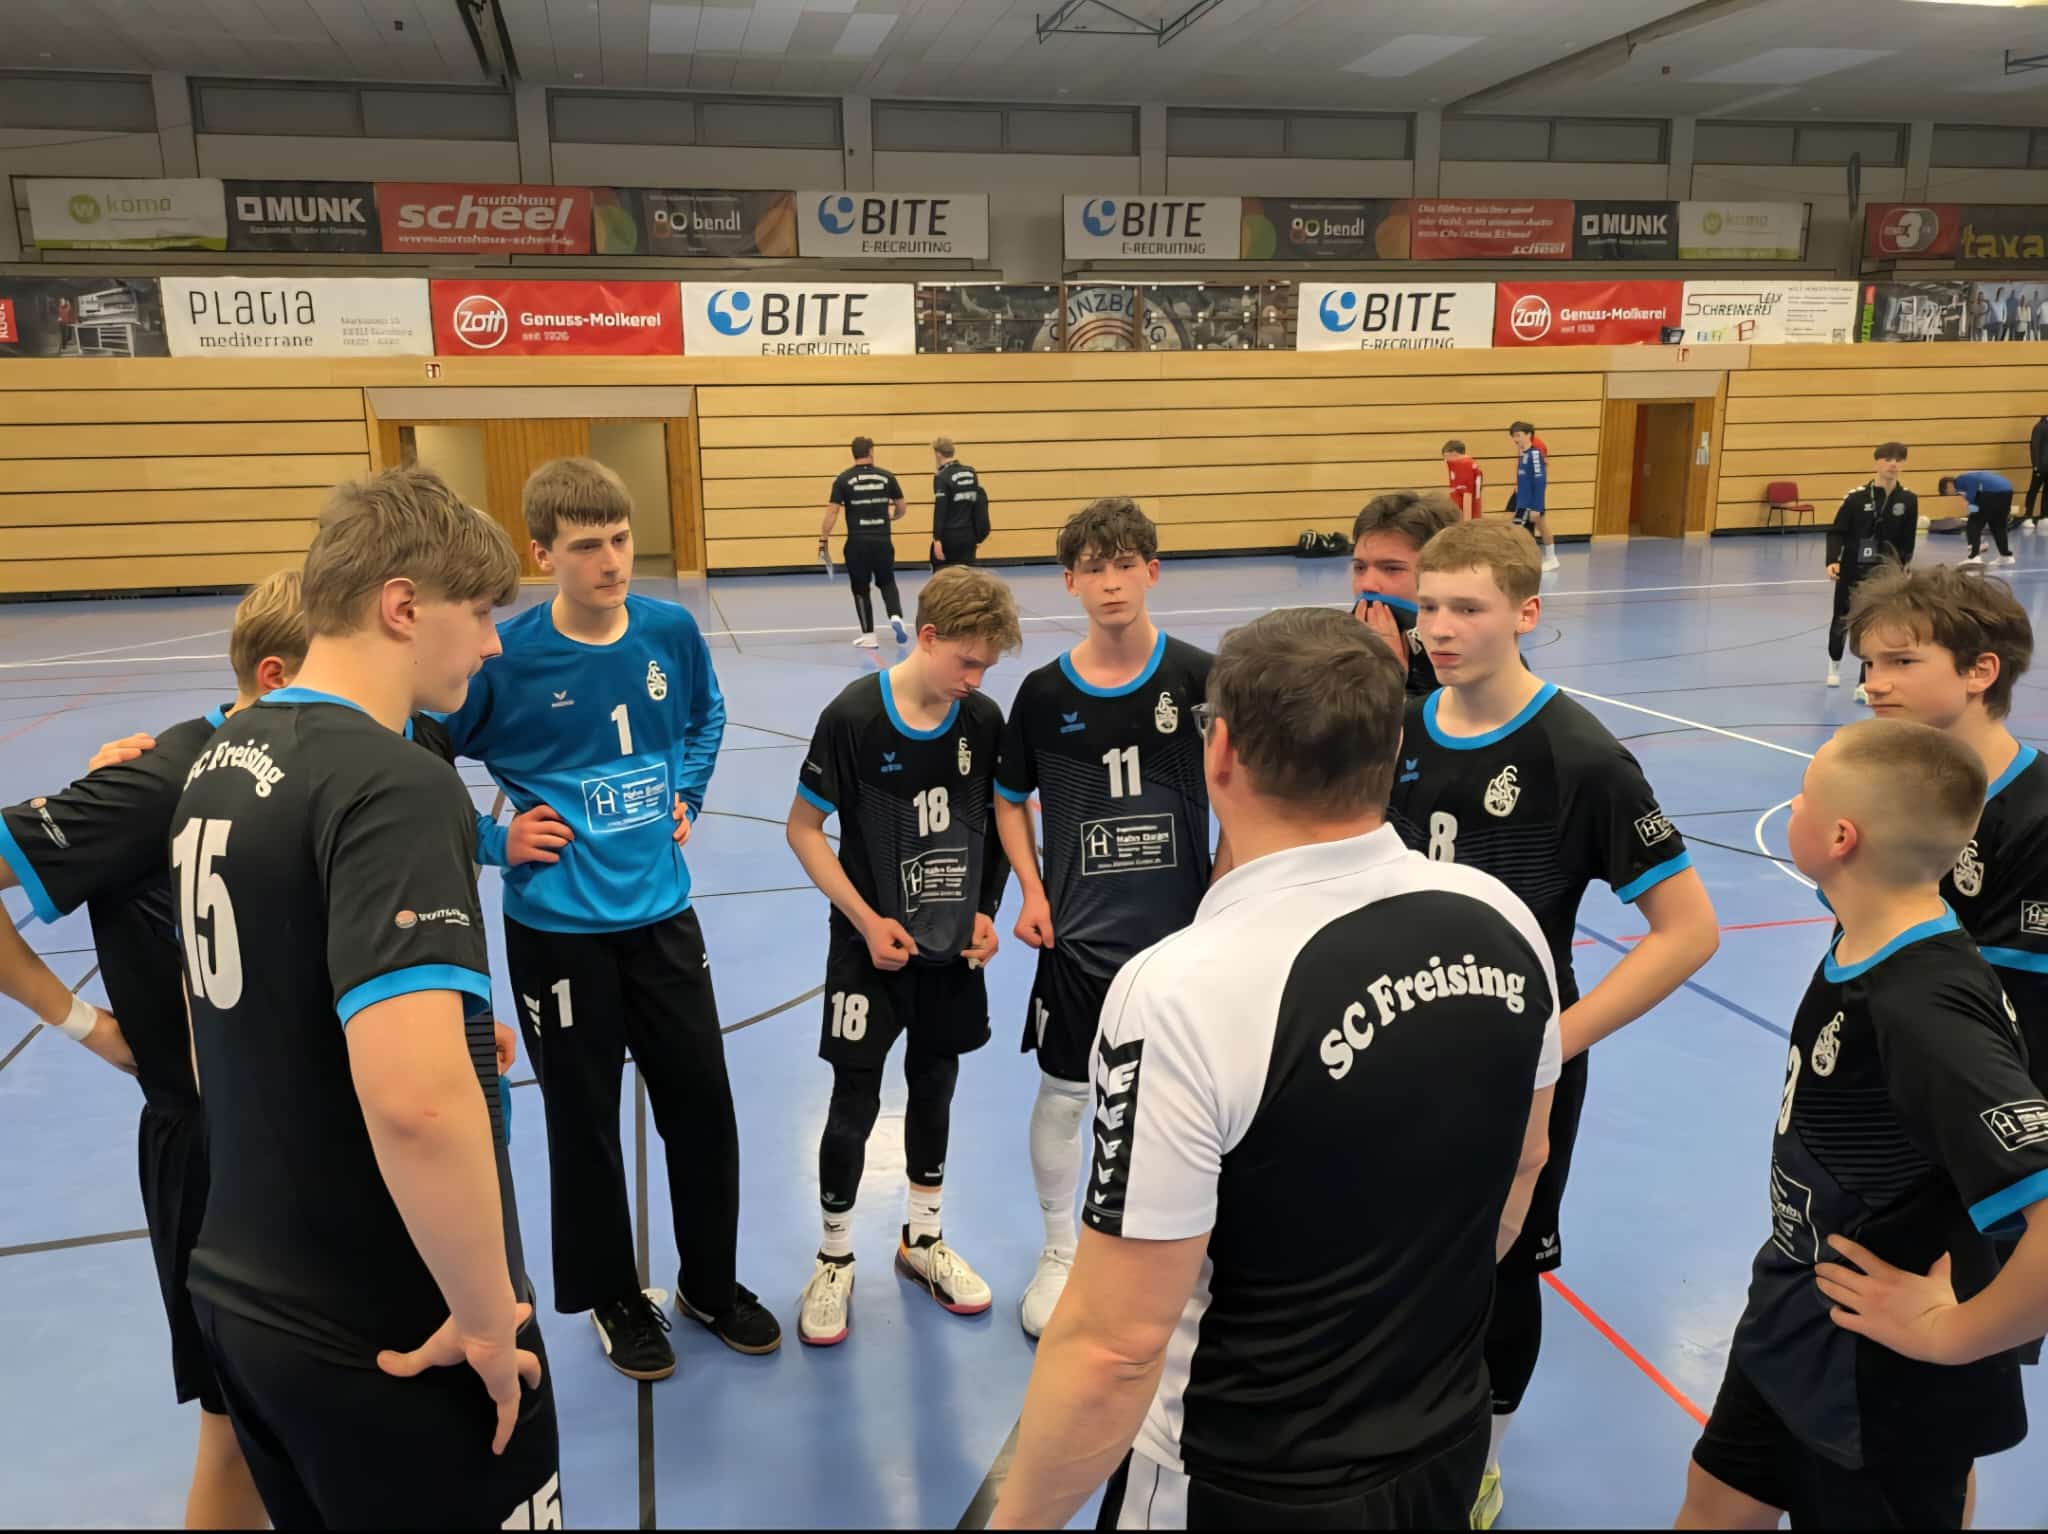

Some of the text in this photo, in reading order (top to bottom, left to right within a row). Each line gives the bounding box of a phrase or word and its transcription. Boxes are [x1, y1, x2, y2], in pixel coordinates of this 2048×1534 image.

[265, 196, 366, 223] MUNK
[398, 195, 573, 230] scheel
[694, 210, 741, 231] bendl
[862, 199, 950, 235] BITE
[1122, 202, 1206, 237] BITE
[1602, 214, 1668, 235] MUNK
[1324, 218, 1364, 236] bendl
[862, 240, 952, 253] E-RECRUITING
[1122, 242, 1206, 254] E-RECRUITING
[1512, 242, 1566, 255] scheel
[459, 311, 504, 333] Zott
[520, 312, 661, 327] Genuss-Molkerei
[761, 293, 869, 336] BITE
[1362, 292, 1456, 332] BITE
[1515, 308, 1549, 327] Zott
[1560, 308, 1666, 321] Genuss-Molkerei
[200, 334, 313, 347] mediterrane
[761, 343, 871, 355] E-RECRUITING
[1361, 338, 1455, 349] E-RECRUITING
[611, 704, 633, 755] 1
[207, 739, 285, 798] Freising
[1102, 745, 1142, 798] 11
[913, 787, 950, 837] 18
[1428, 811, 1458, 864] 8
[172, 818, 243, 1009] 15
[552, 979, 573, 1028] 1
[831, 991, 869, 1041] 18
[1320, 953, 1526, 1080] SC Freising
